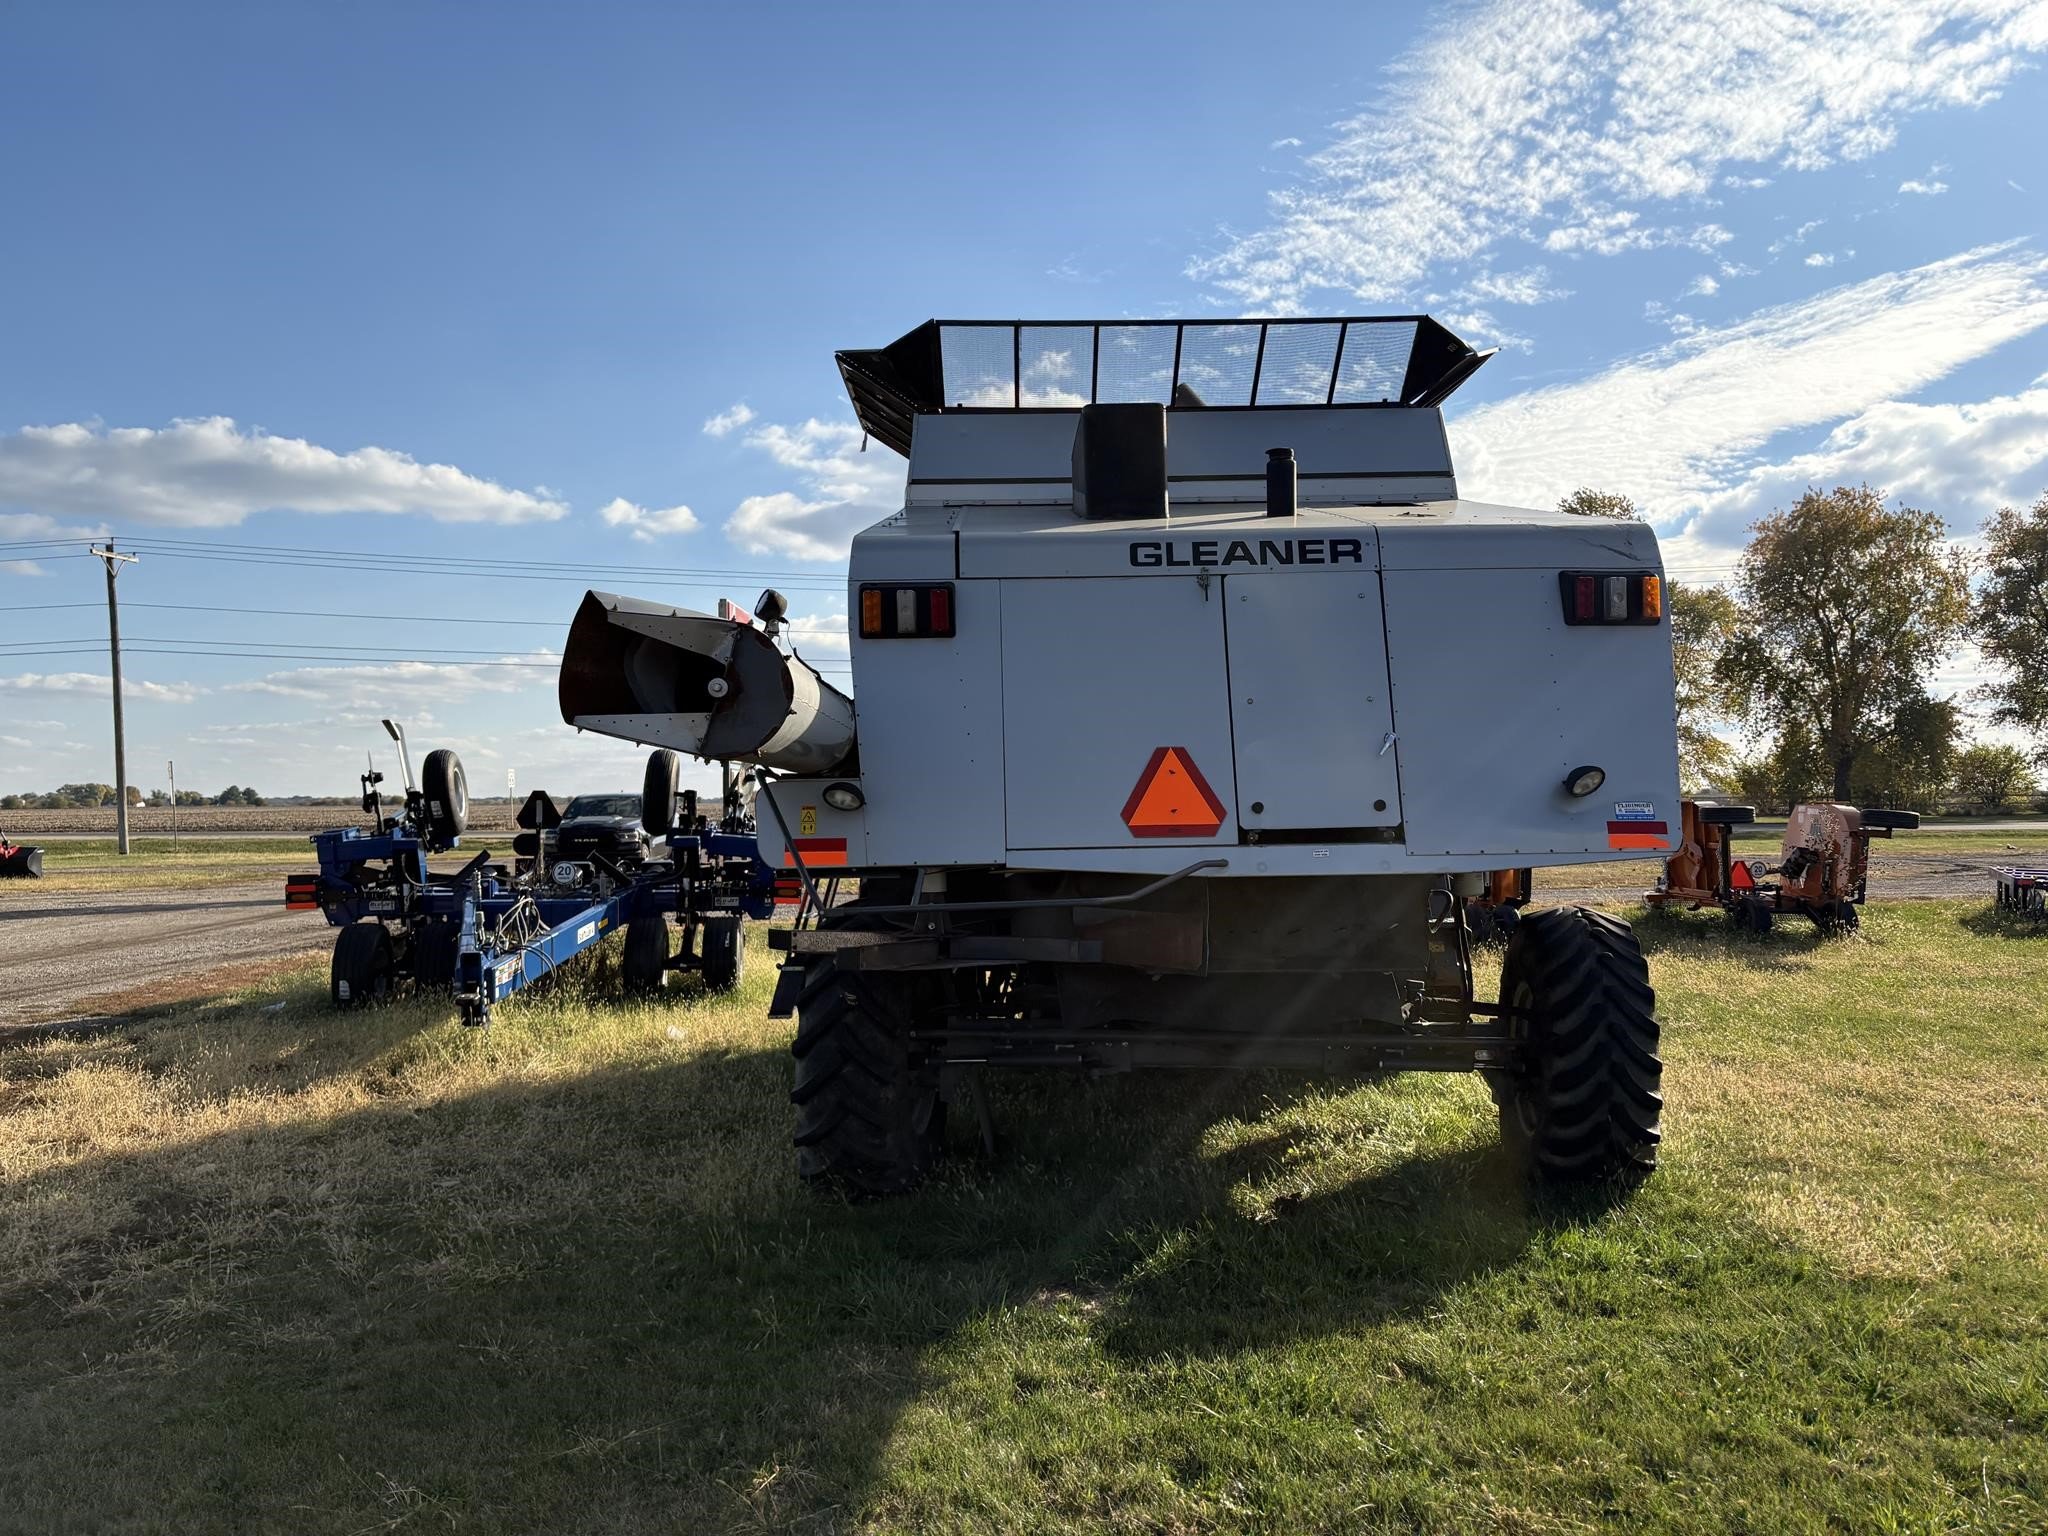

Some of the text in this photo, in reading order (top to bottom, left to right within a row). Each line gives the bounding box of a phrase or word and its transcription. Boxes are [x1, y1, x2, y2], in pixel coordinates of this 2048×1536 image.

[1129, 539, 1362, 567] GLEANER
[557, 866, 572, 876] 20
[1754, 865, 1763, 873] 20
